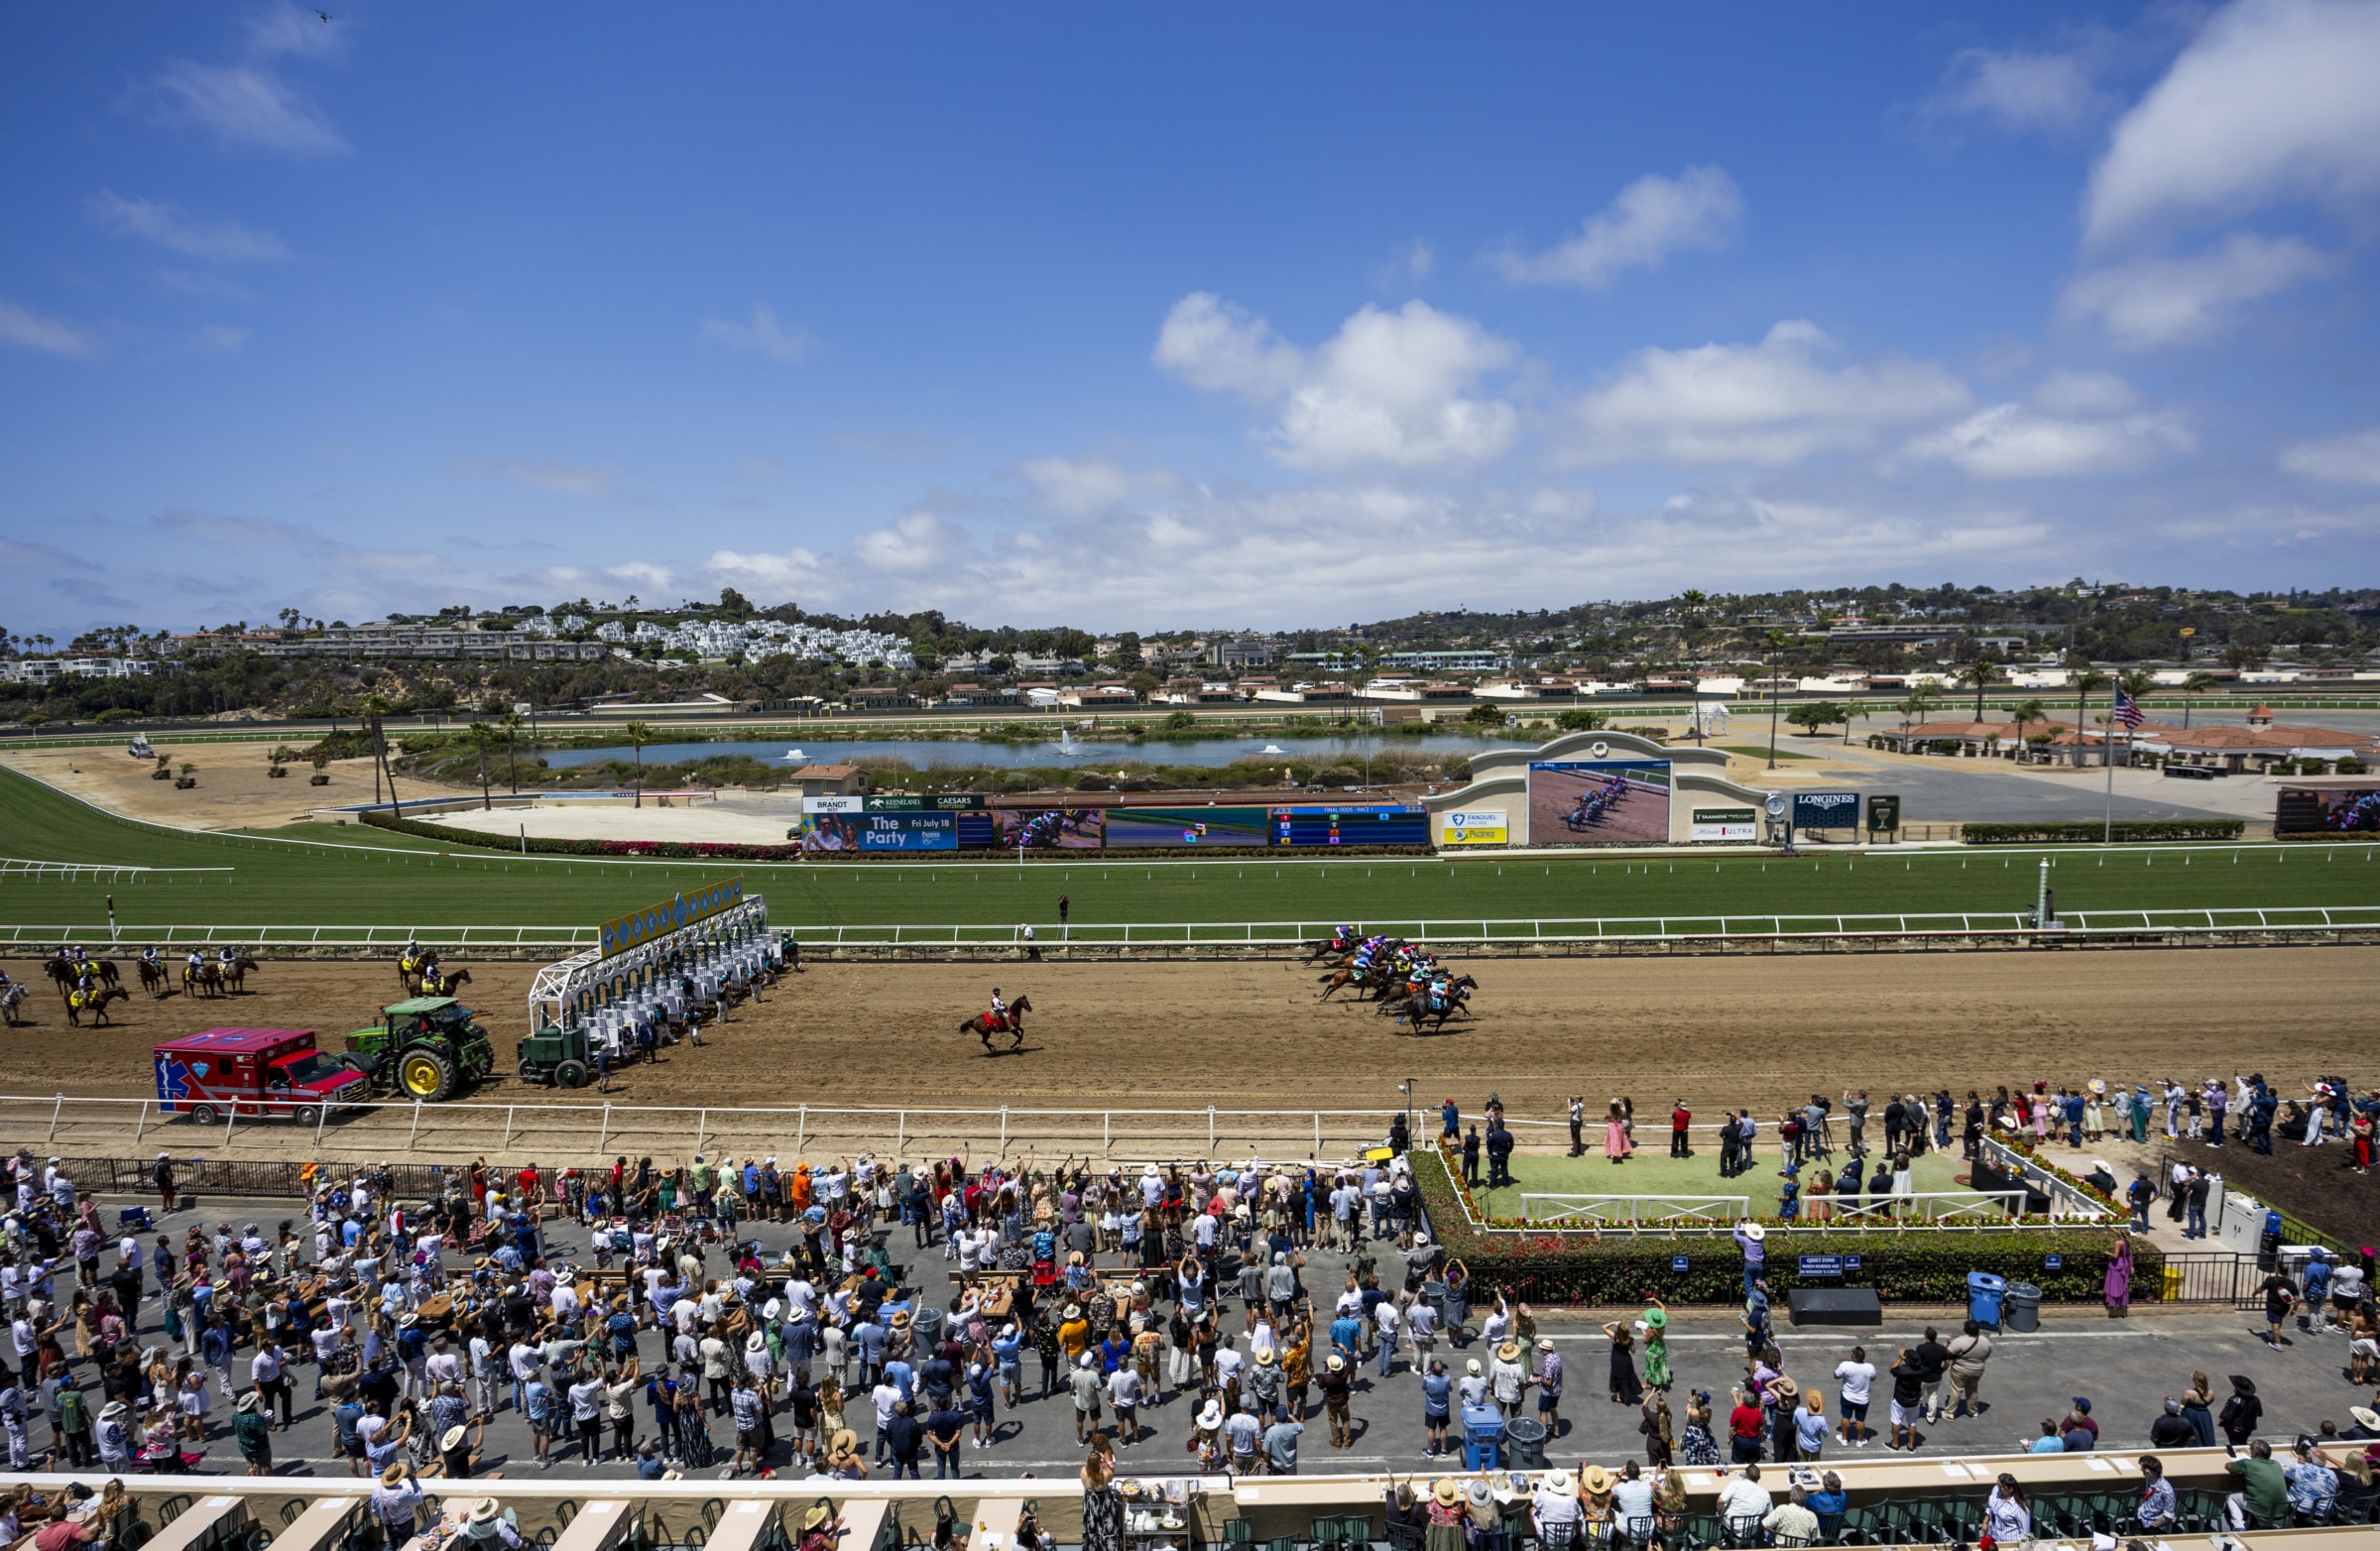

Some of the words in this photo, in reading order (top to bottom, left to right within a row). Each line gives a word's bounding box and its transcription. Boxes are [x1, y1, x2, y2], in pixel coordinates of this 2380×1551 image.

[1798, 794, 1855, 804] LONGINES
[871, 816, 899, 830] The
[911, 819, 922, 828] Fri
[922, 818, 939, 829] July
[866, 830, 906, 847] Party
[635, 913, 668, 934] DEL
